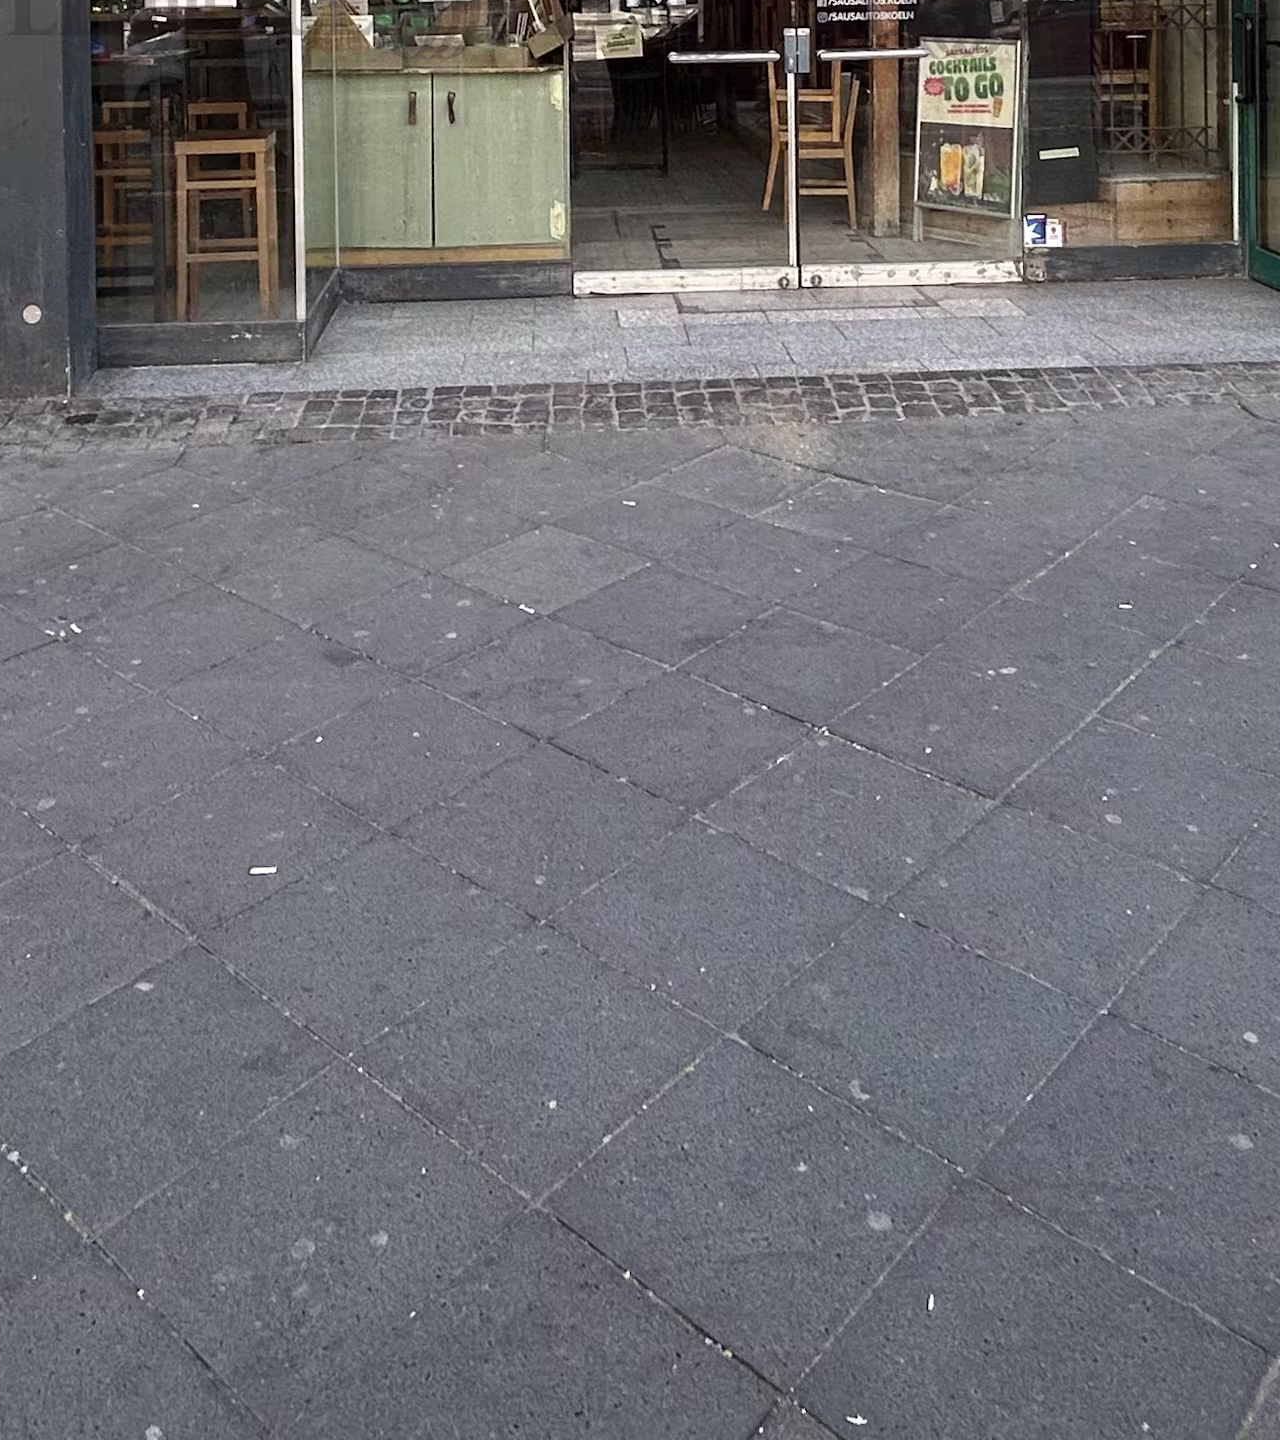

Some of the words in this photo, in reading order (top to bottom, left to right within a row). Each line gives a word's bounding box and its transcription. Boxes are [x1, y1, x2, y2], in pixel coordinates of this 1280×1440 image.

[929, 56, 997, 75] COCKTAILS
[943, 76, 970, 102] TO
[974, 73, 1004, 99] GO
